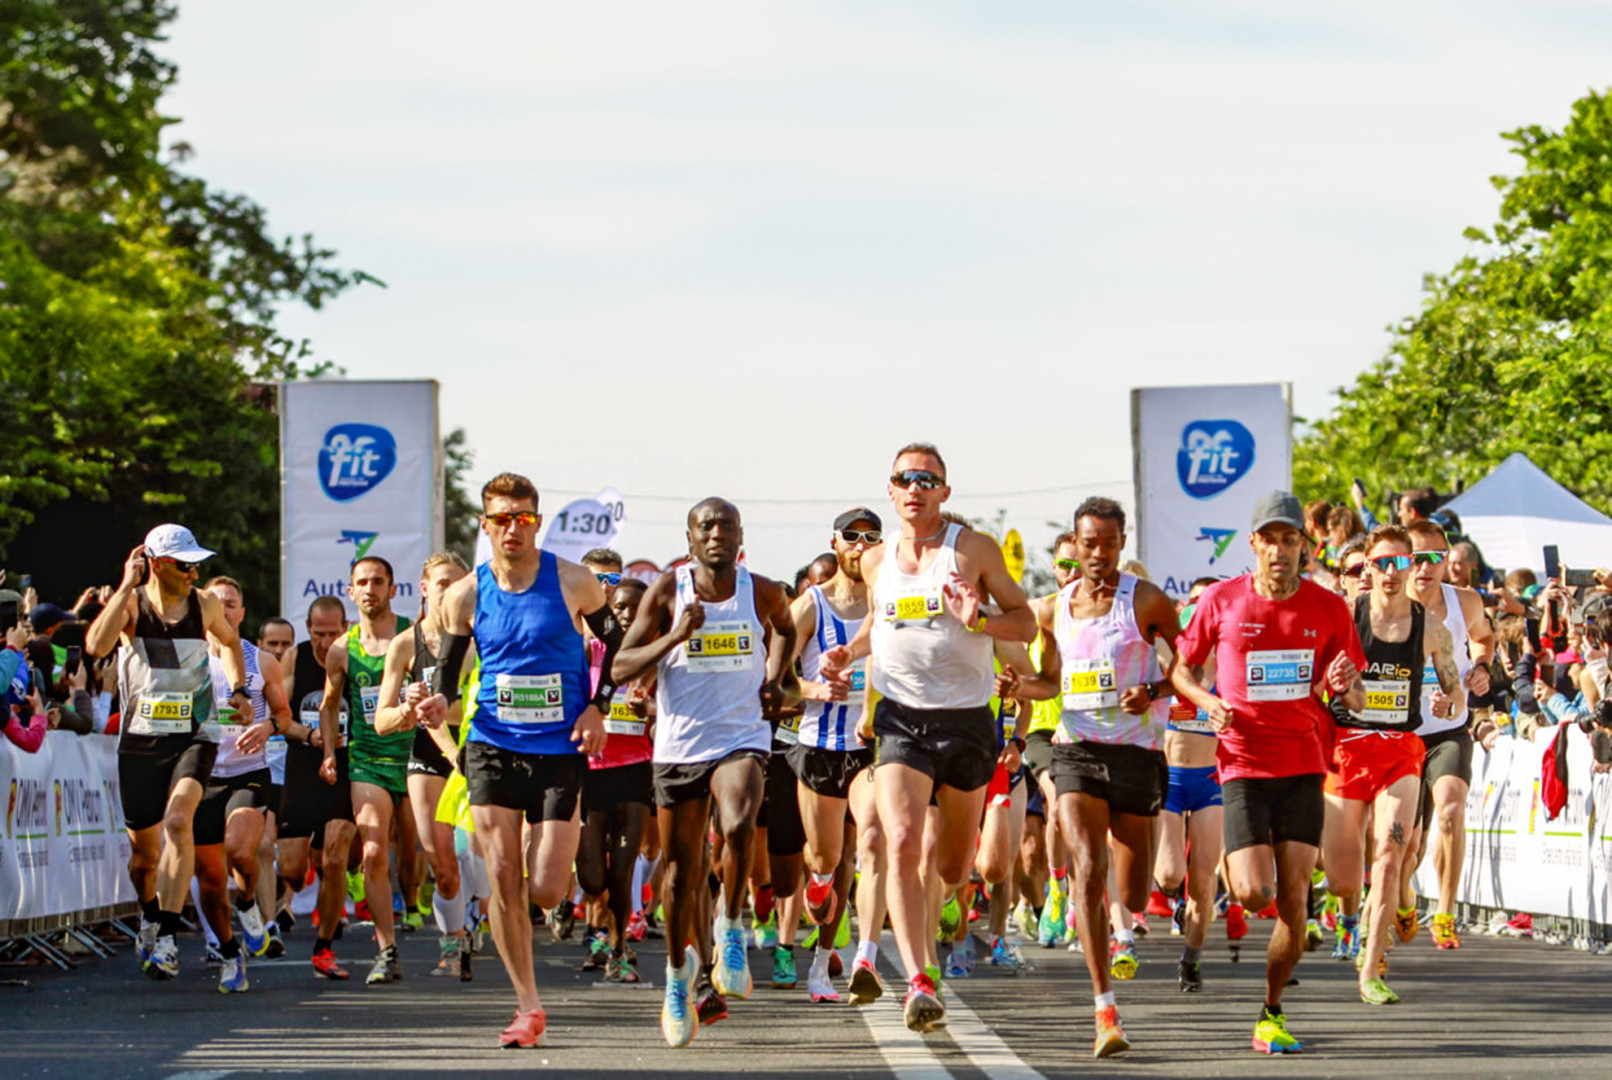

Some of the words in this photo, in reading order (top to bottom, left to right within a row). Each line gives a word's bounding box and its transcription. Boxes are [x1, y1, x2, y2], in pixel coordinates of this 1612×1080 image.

[558, 510, 611, 535] 1:30
[706, 637, 736, 650] 1646
[1364, 661, 1412, 678] ARio
[1367, 694, 1394, 705] 1505
[154, 704, 179, 715] 1793
